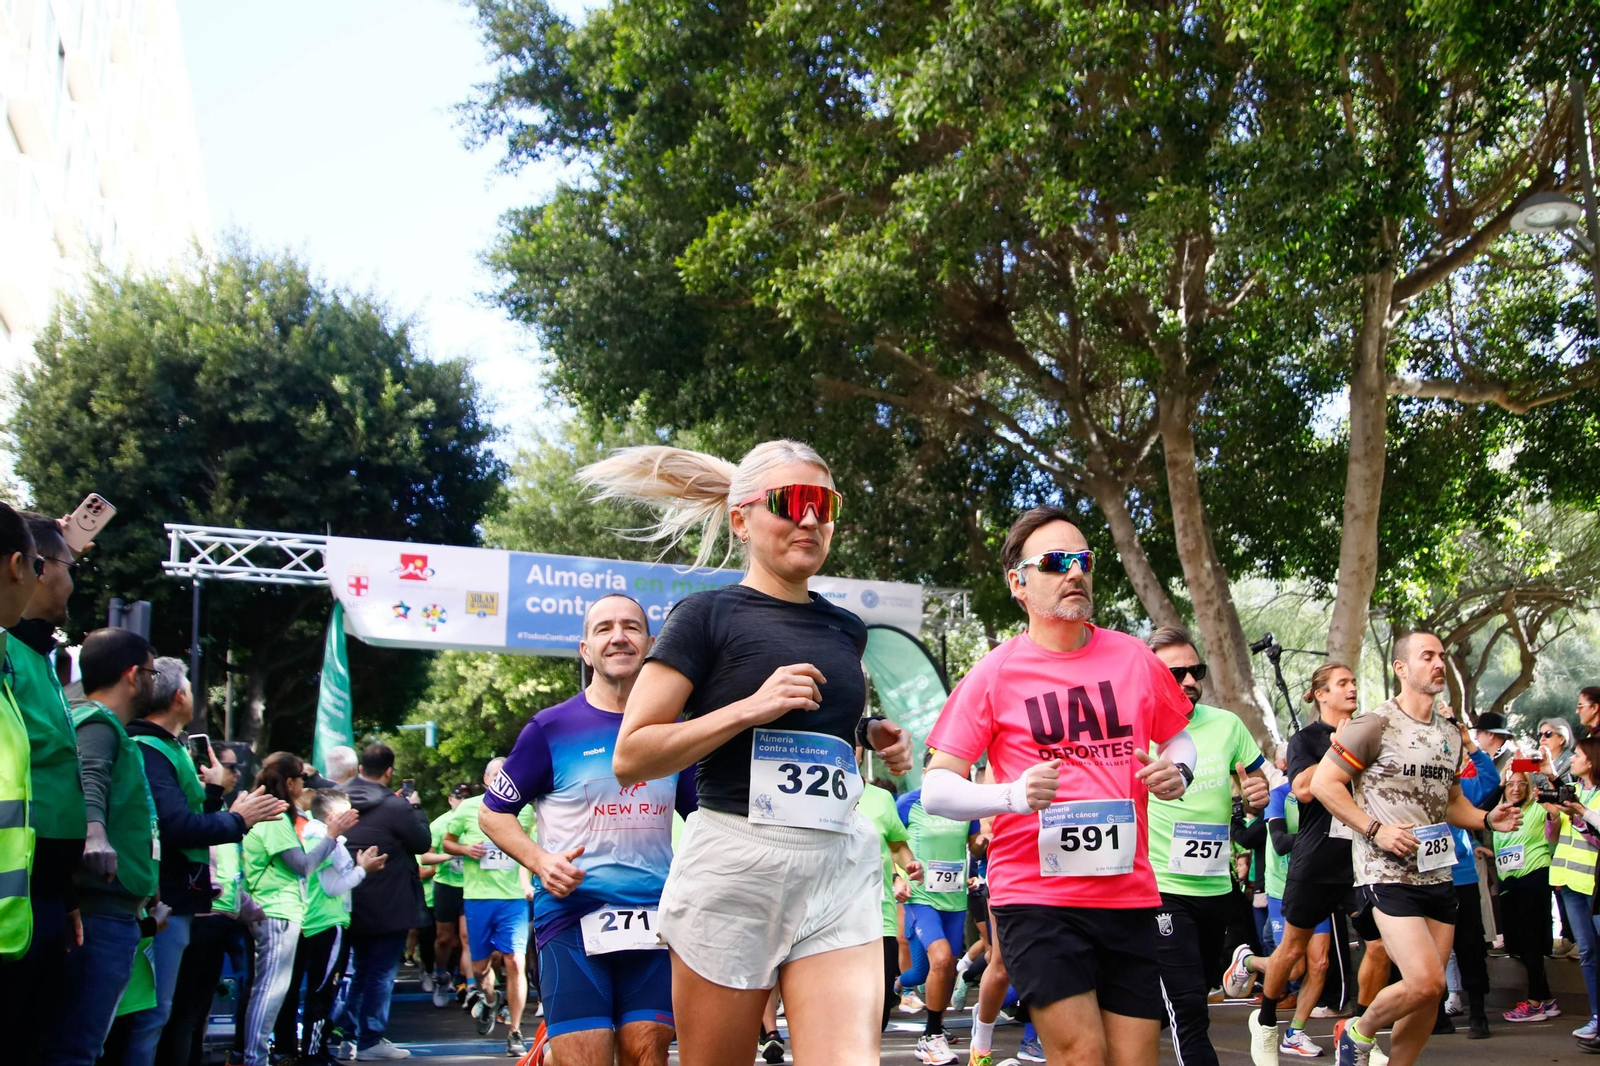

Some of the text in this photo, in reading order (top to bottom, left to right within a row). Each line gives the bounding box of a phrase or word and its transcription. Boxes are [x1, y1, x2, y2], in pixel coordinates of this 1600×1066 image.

[526, 564, 627, 591] Almería
[634, 576, 663, 592] en
[517, 632, 585, 642] #TodosContraElC
[1024, 680, 1134, 746] UAL
[759, 733, 794, 744] Almería
[759, 745, 828, 756] contra el cáncer
[1038, 740, 1134, 762] DEPORTES
[1403, 763, 1416, 777] LA
[777, 763, 848, 800] 326
[594, 803, 632, 816] NEW
[1044, 813, 1066, 822] contra
[1075, 811, 1099, 819] cáncer
[1060, 824, 1119, 852] 591
[488, 850, 508, 860] 21
[1184, 839, 1223, 859] 257
[1425, 837, 1448, 857] 283
[1497, 852, 1521, 866] 1079
[598, 910, 650, 933] 271
